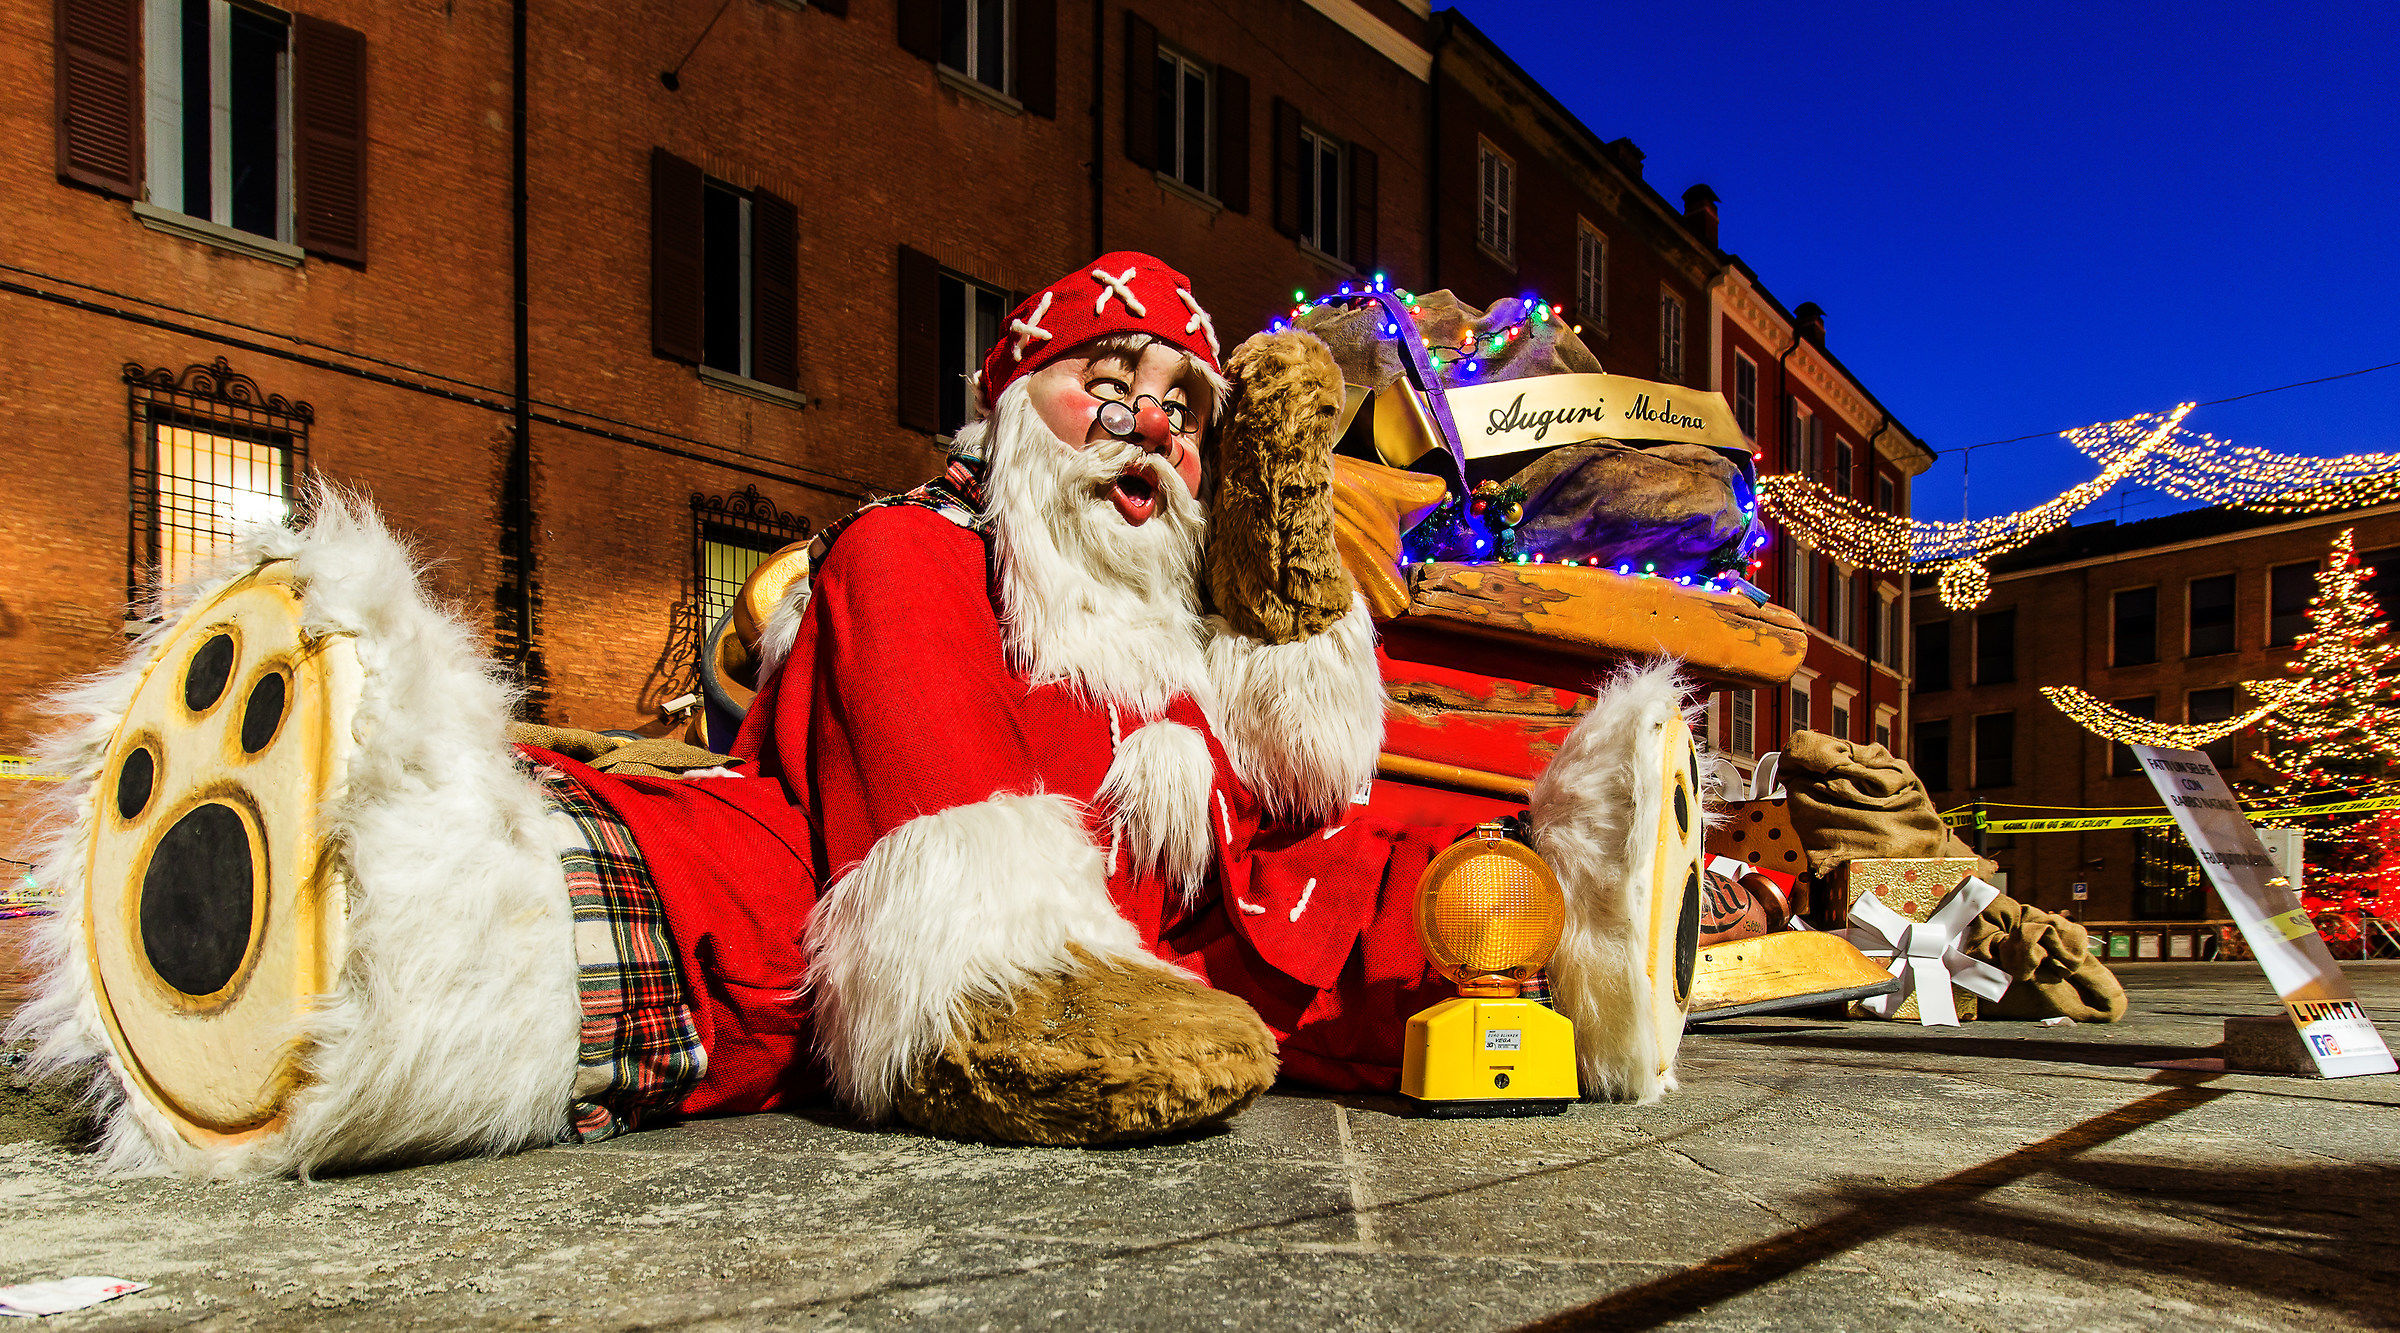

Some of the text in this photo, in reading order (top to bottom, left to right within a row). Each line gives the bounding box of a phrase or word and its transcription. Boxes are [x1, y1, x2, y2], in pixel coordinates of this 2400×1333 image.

[1486, 392, 1706, 441] Auguri Modena
[2181, 778, 2204, 791] CON
